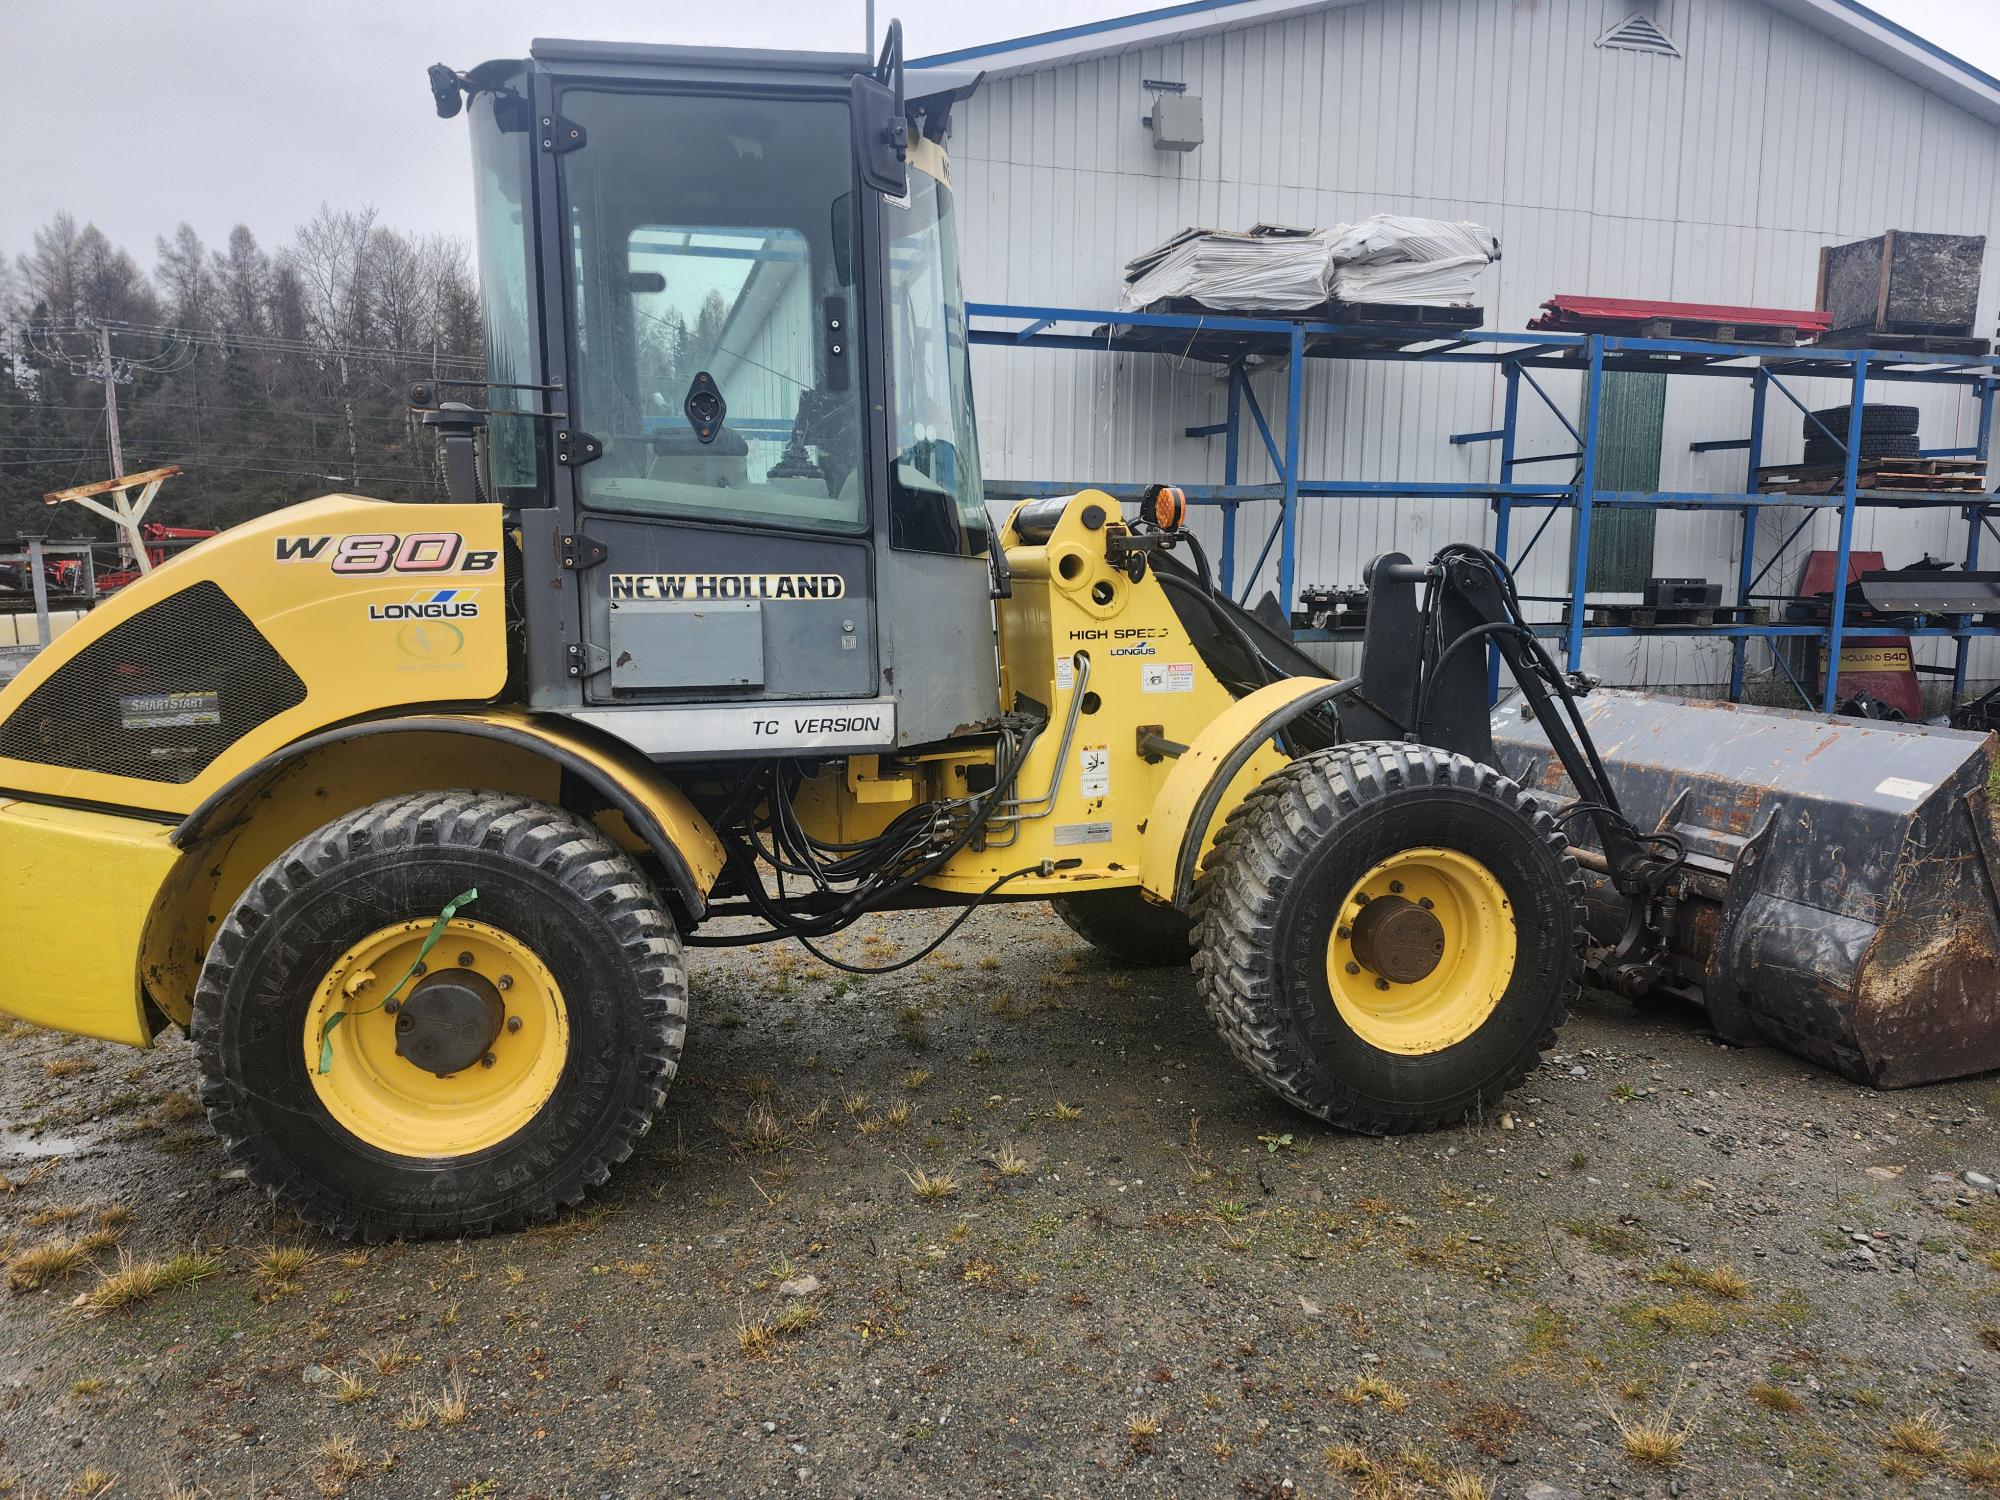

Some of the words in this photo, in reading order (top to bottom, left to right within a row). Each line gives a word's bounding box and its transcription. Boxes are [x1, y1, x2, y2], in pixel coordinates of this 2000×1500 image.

[611, 575, 686, 598] NEW
[695, 576, 842, 599] HOLLAND
[369, 603, 478, 620] LONGUS
[1069, 630, 1108, 640] HIGH
[1110, 648, 1156, 656] LONGUS
[1841, 654, 1882, 662] HOLLAND
[1883, 652, 1908, 662] 640
[752, 720, 779, 735] TC
[794, 716, 881, 734] VERSION
